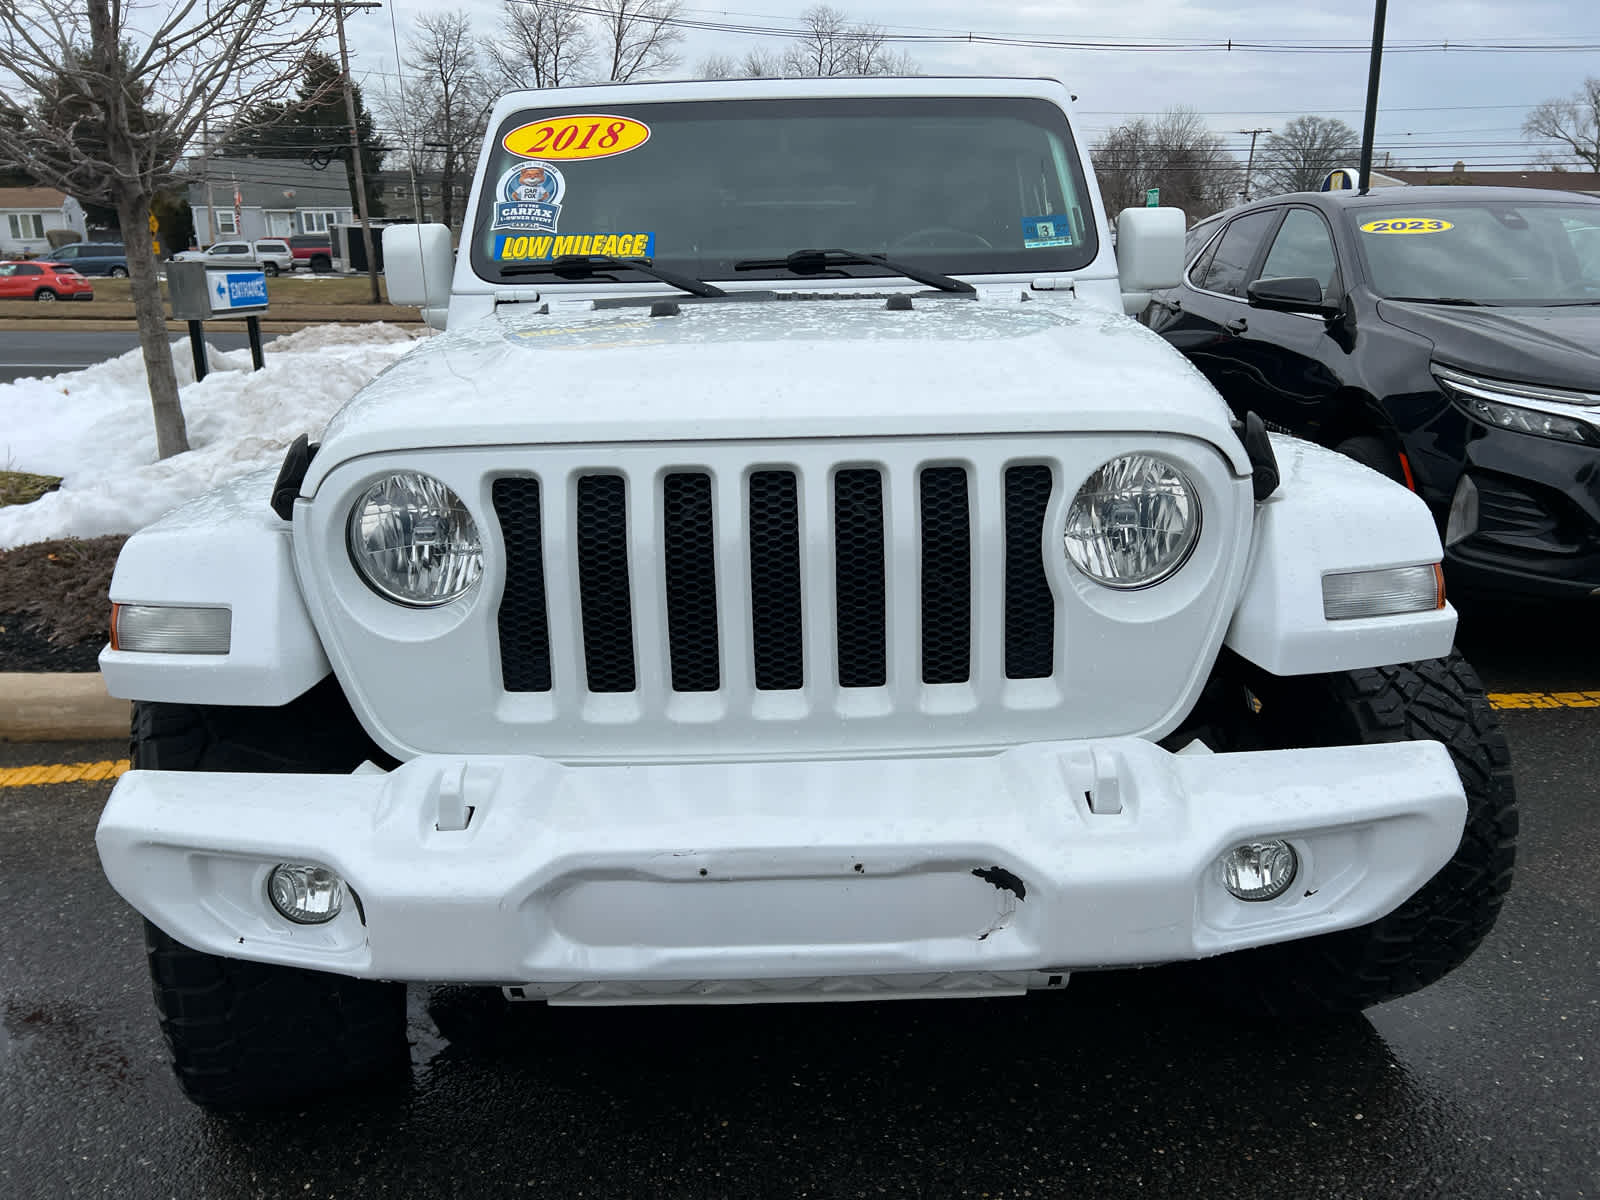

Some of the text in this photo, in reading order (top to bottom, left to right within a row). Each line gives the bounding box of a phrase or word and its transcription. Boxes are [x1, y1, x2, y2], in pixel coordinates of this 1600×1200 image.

[525, 121, 626, 153] 2018
[502, 207, 553, 218] CARFAX
[1041, 225, 1050, 236] 3
[1372, 221, 1444, 232] 2023
[501, 234, 649, 260] LOW MILEAGE
